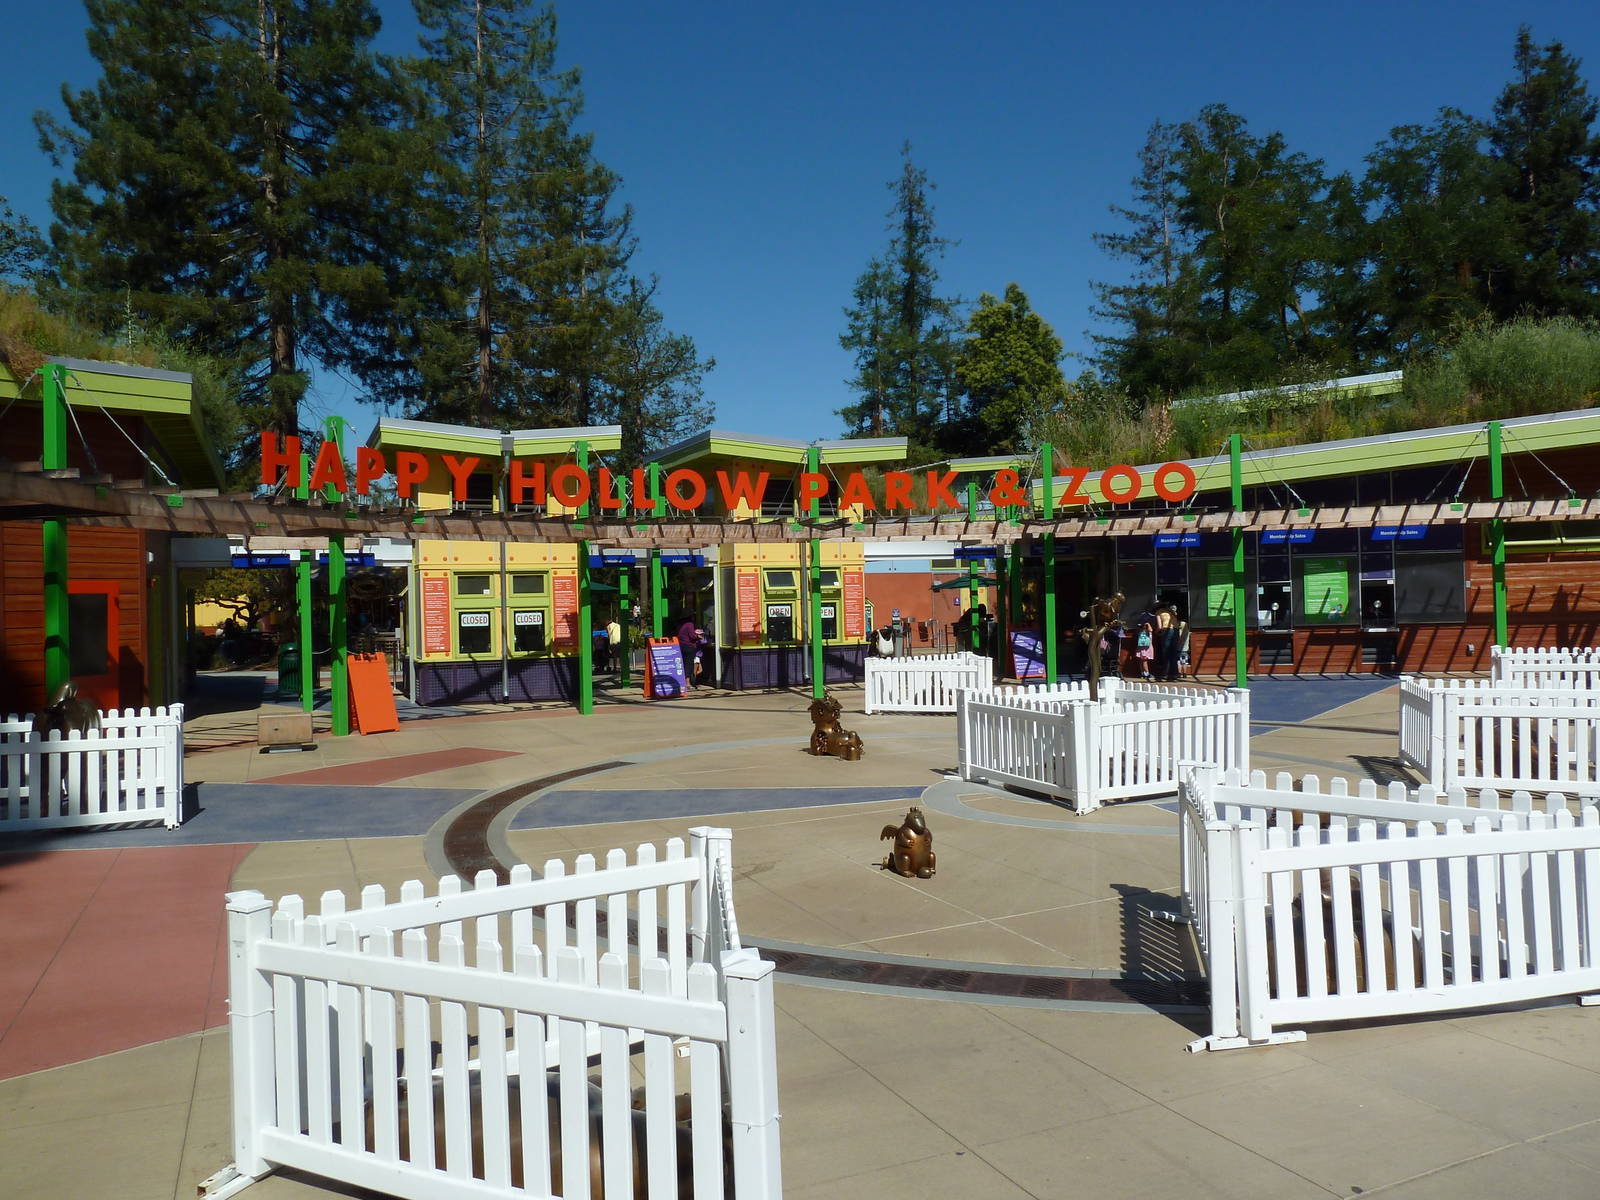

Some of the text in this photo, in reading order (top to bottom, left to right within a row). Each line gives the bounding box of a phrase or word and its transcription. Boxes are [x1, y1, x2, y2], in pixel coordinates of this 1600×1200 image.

[261, 431, 1196, 510] HAPPY HOLLOW PARK & ZOO
[769, 608, 790, 616] OPEN
[821, 608, 833, 616] EN
[462, 616, 488, 624] CLOSED
[516, 615, 541, 623] CLOSED
